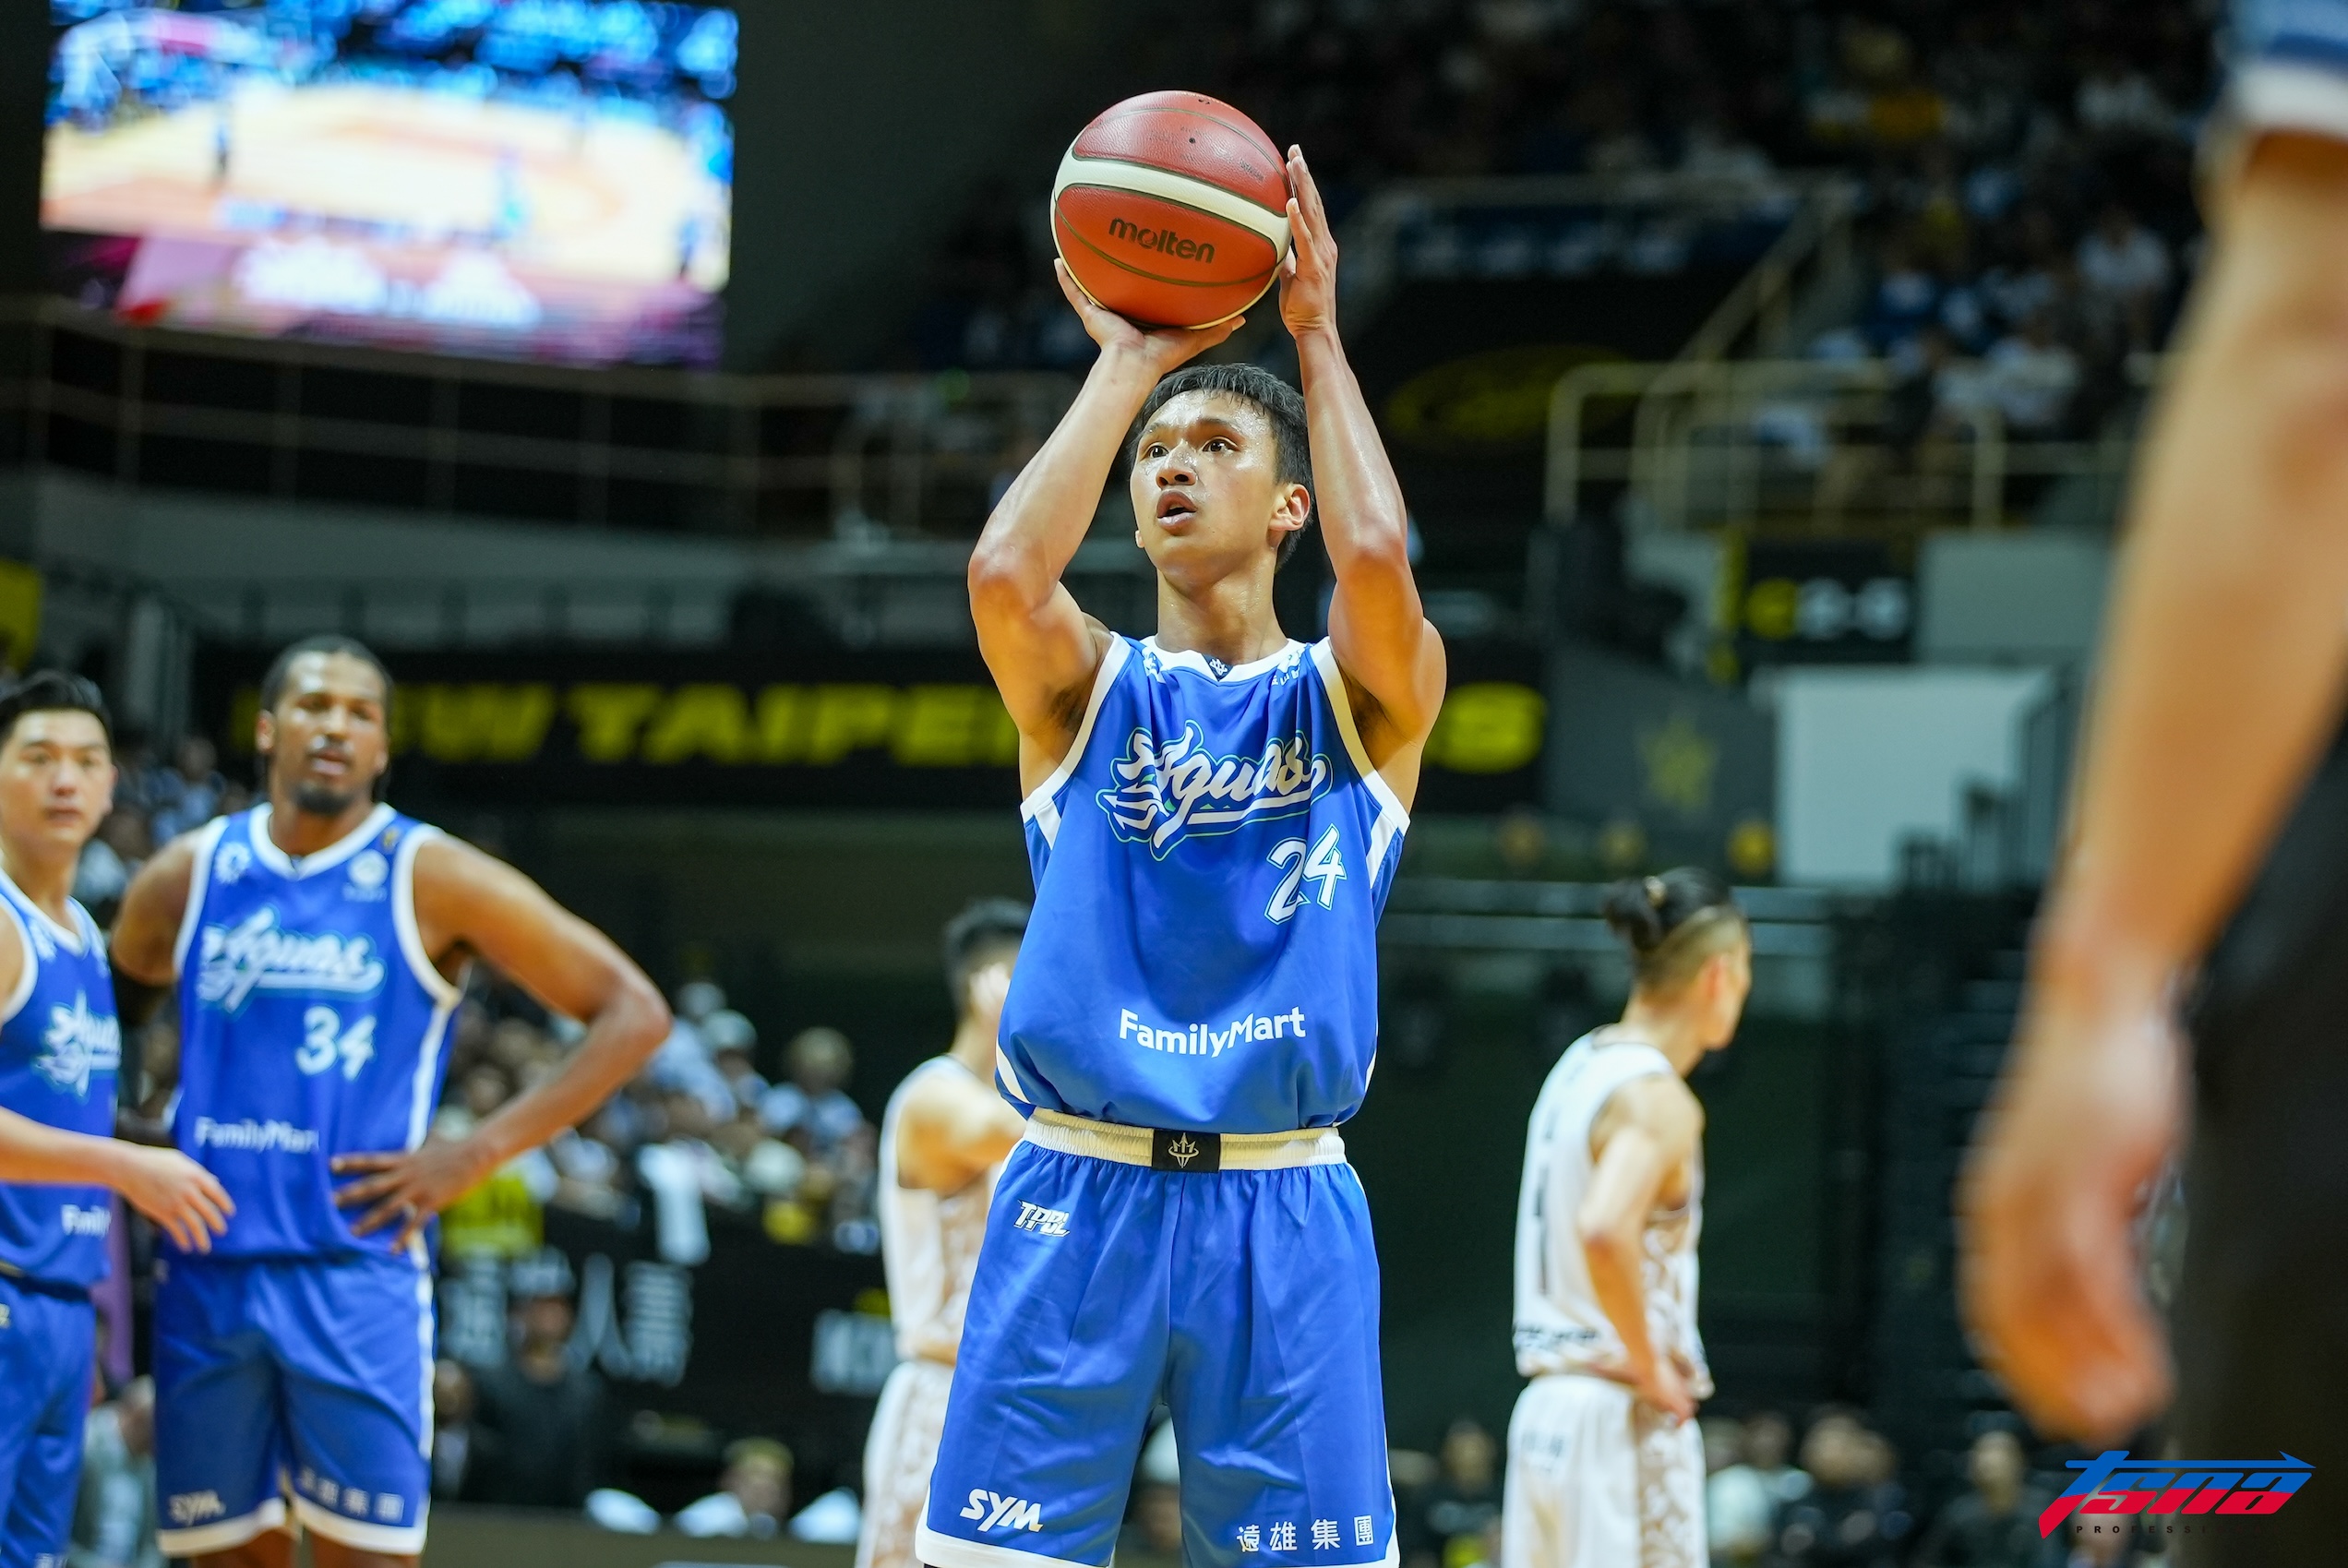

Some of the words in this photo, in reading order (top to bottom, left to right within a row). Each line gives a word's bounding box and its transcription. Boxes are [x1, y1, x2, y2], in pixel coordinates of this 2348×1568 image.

[1108, 218, 1216, 264] molten
[1099, 722, 1332, 856] Aquas
[1265, 823, 1348, 925] 24
[295, 1004, 377, 1082] 34
[1119, 1006, 1306, 1058] FamilyMart
[194, 1115, 320, 1155] FamilyMar
[1014, 1200, 1071, 1238] TPBL
[959, 1488, 1044, 1533] SYM
[1236, 1514, 1374, 1552] 遠雄集團
